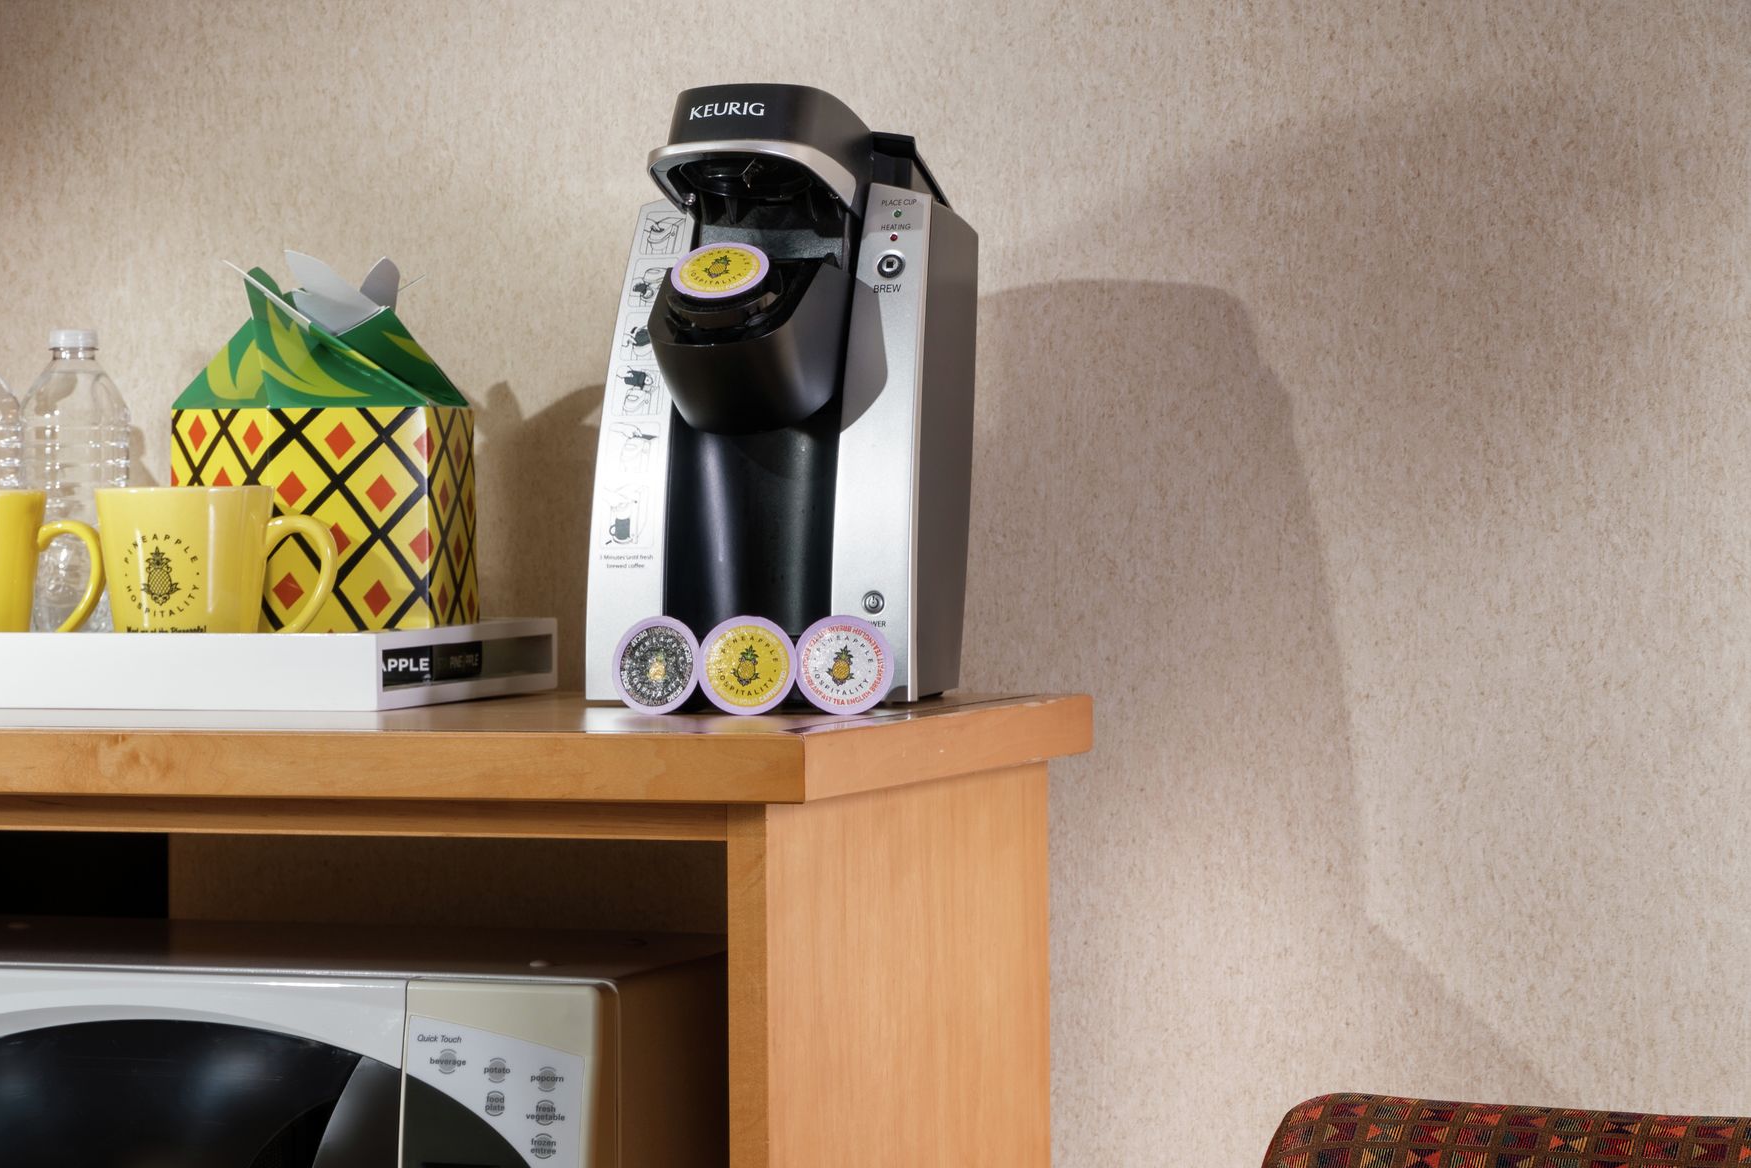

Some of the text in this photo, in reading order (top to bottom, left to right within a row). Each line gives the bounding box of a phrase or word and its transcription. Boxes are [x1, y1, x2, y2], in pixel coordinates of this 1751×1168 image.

[689, 102, 765, 120] KEURIG
[873, 285, 901, 293] BREW
[124, 534, 198, 564] PINEAPPLE
[126, 585, 199, 618] HOSPITALITY
[721, 636, 778, 662] PINEAPPLE
[817, 635, 874, 663] PINEAPPLE
[718, 668, 774, 696] HOSPITALITY
[814, 667, 869, 695] HOSPITALITY
[417, 1034, 462, 1044] Quick Touch
[430, 1057, 466, 1067] beverage
[484, 1066, 510, 1075] potato
[531, 1074, 564, 1083] popcorn
[487, 1096, 505, 1104] food
[485, 1104, 505, 1113] plate
[536, 1105, 556, 1113] fresh
[526, 1112, 565, 1122] vegetable
[531, 1139, 556, 1147] frozen
[531, 1147, 556, 1155] entree
